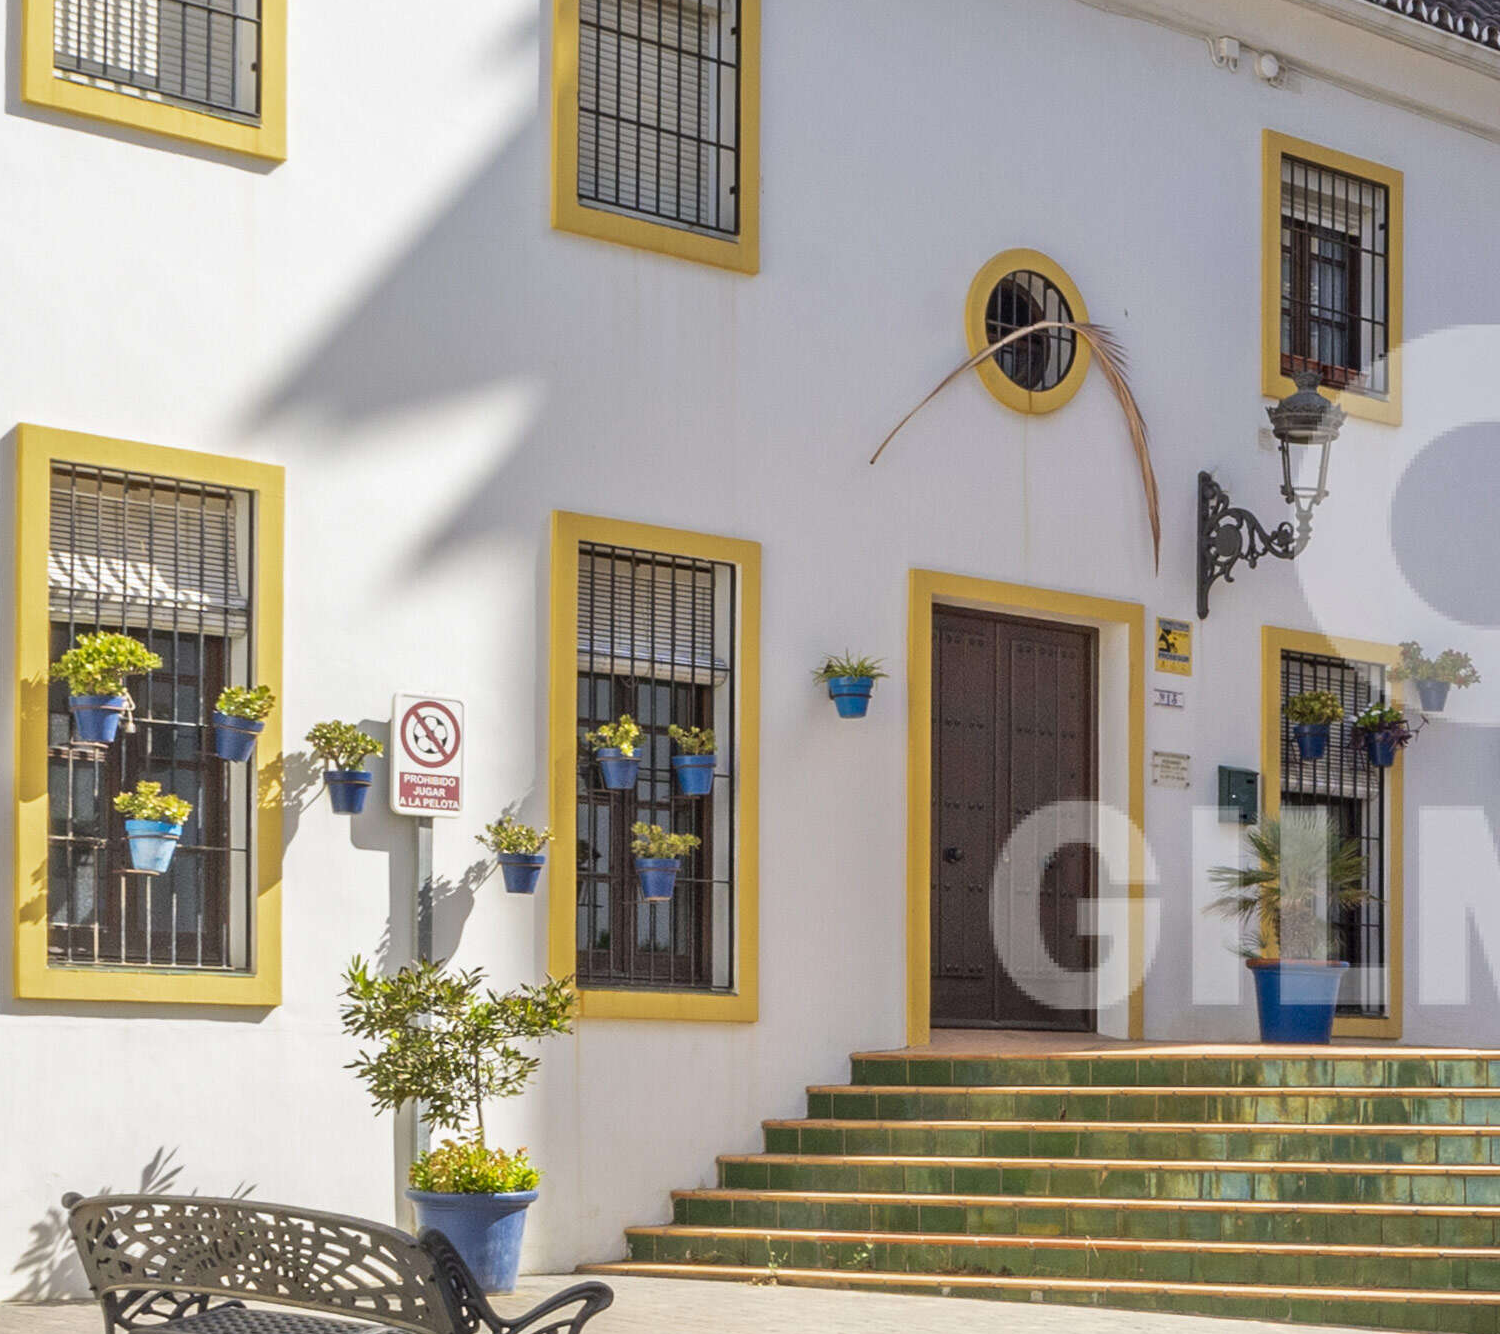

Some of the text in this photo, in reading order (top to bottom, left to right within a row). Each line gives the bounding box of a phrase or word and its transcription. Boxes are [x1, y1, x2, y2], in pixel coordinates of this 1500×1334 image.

[404, 775, 456, 786] PROHIBIDO
[413, 787, 446, 797] JUGAR
[400, 795, 459, 809] A LA PELOTA
